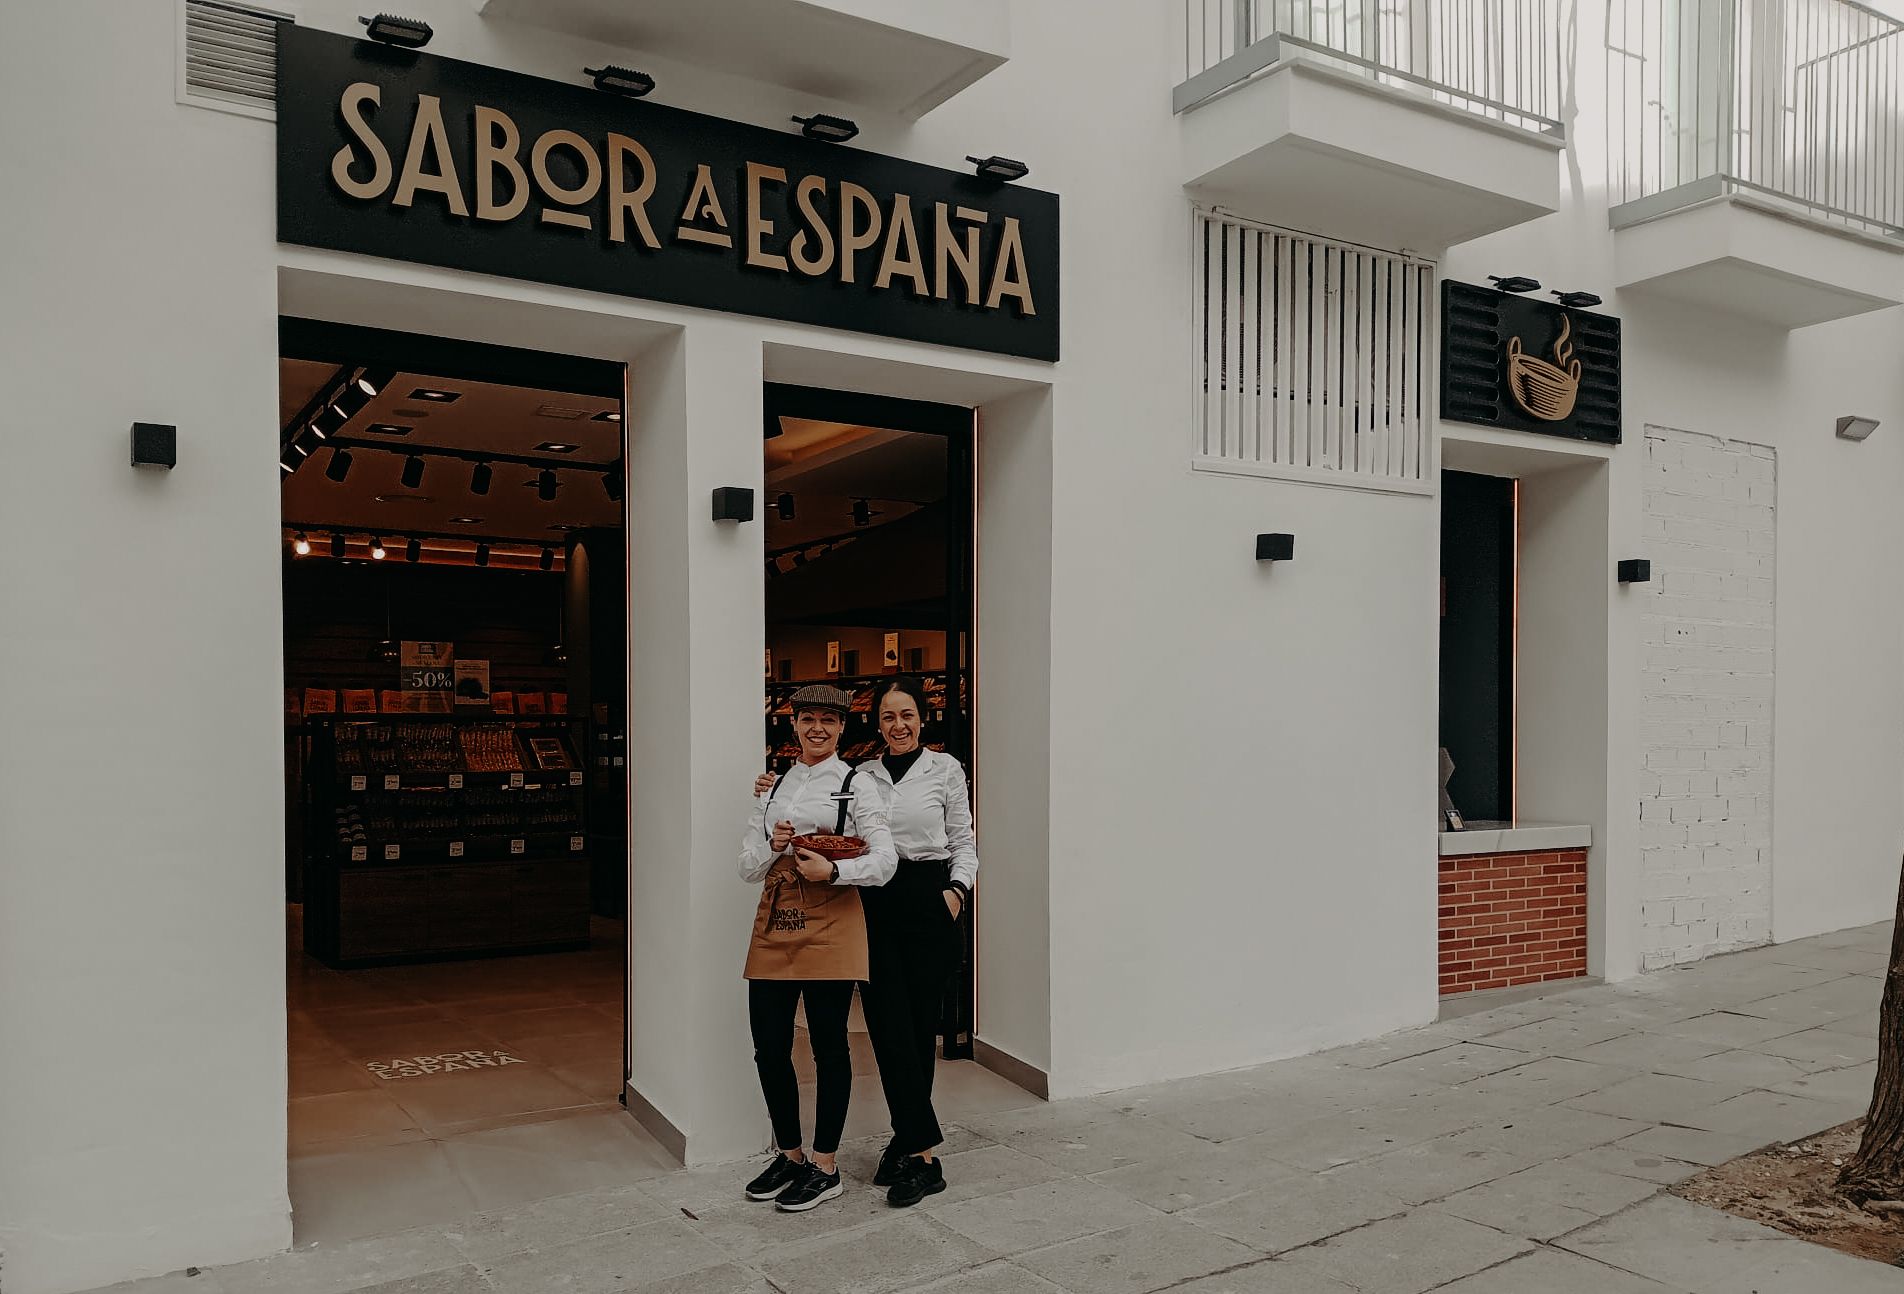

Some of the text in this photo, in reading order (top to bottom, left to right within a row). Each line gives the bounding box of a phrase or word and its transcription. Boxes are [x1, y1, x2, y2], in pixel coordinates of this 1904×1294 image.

[330, 81, 1037, 317] SABOR A ESPAÑA
[403, 670, 452, 688] -50%
[366, 1050, 491, 1071] SABOR
